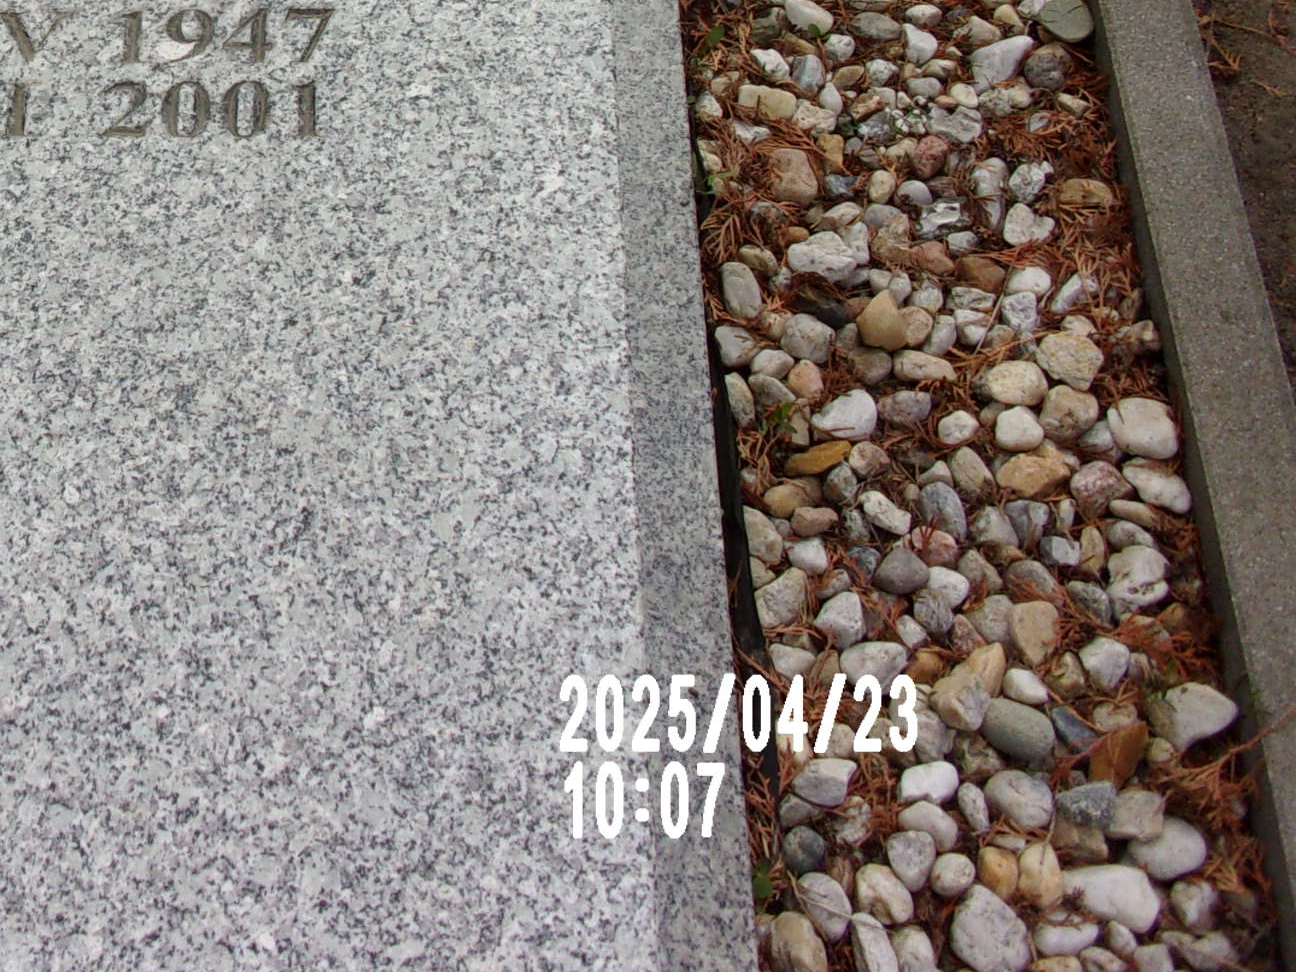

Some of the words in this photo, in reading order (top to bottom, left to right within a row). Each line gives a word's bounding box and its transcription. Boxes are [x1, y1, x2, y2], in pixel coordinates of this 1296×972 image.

[1, 10, 73, 64] V
[107, 7, 336, 65] 1947
[100, 79, 323, 138] 2001
